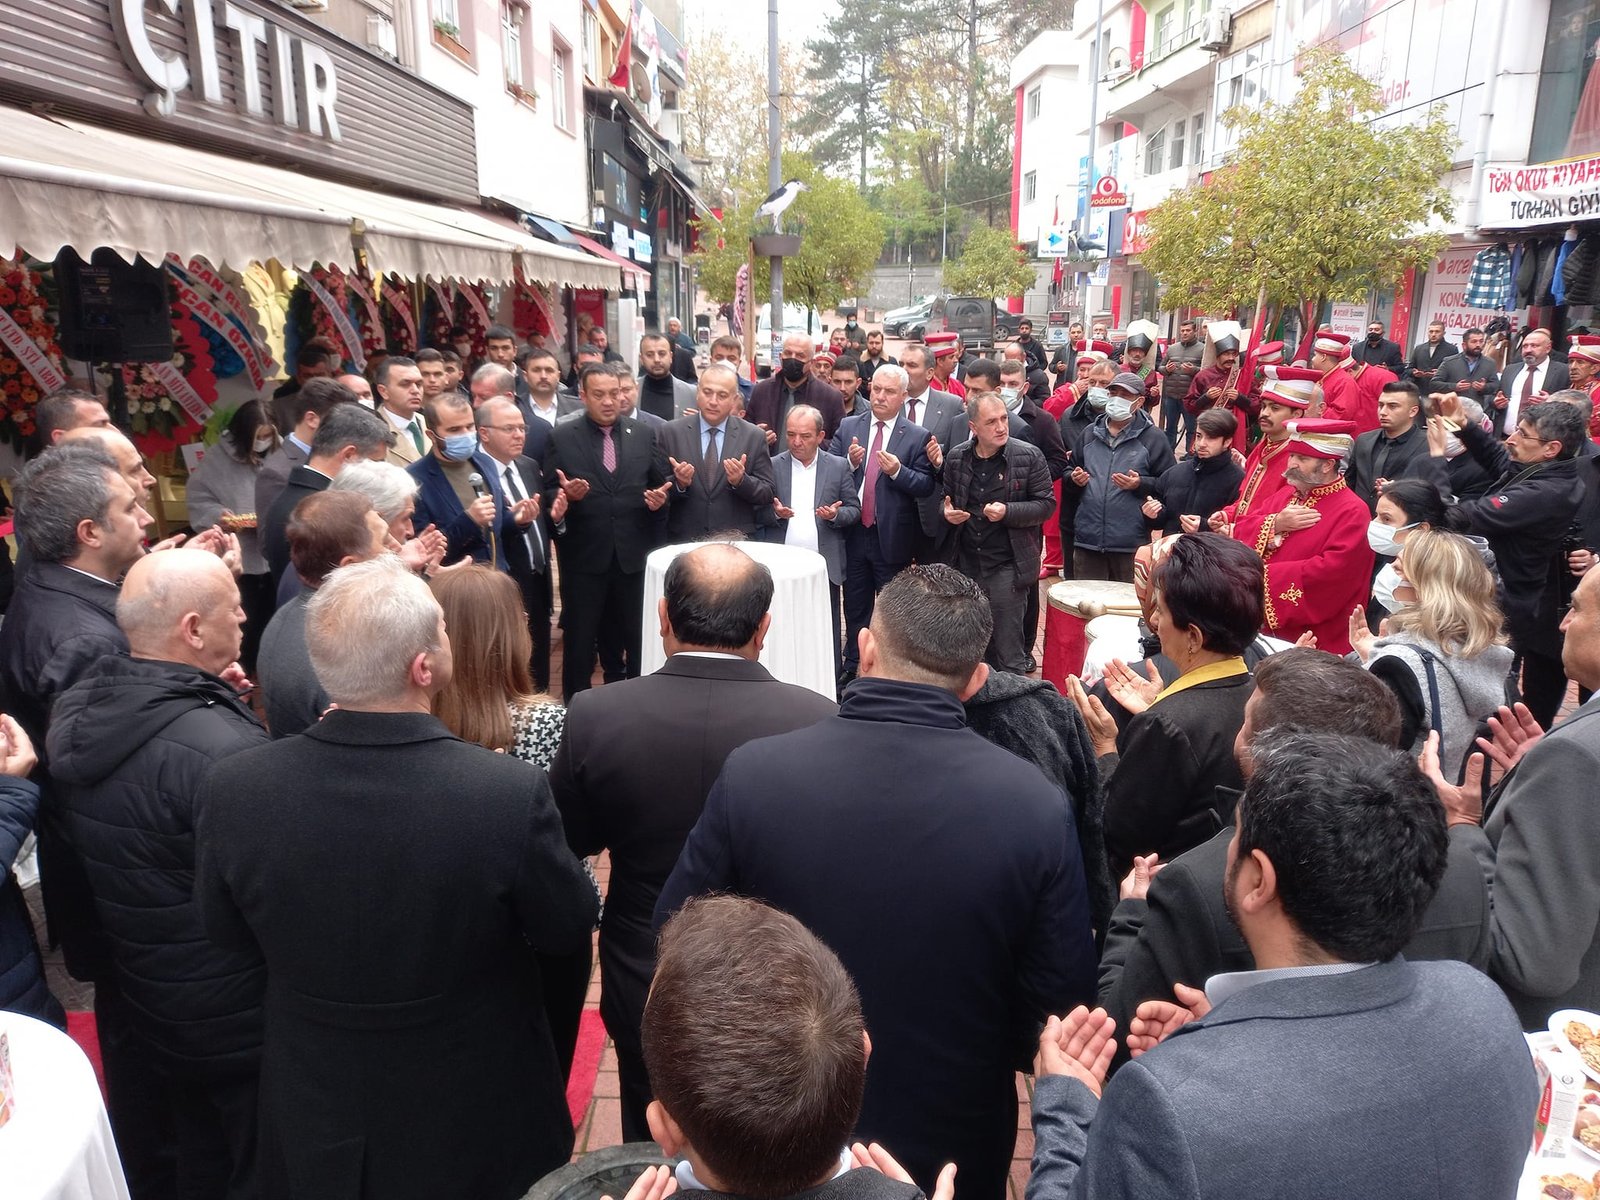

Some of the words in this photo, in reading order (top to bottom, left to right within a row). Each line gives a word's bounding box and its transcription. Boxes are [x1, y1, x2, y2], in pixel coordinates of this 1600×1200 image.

[1378, 79, 1411, 105] arlar.
[1489, 167, 1512, 193] TÜM
[1515, 167, 1549, 192] OKUL
[1090, 196, 1126, 206] vodafone
[1511, 198, 1564, 219] TURHAN
[1446, 258, 1473, 279] arçel
[171, 278, 226, 330] RCAN
[1439, 291, 1468, 308] KONS
[1434, 309, 1519, 333] MAĞAZAMIE
